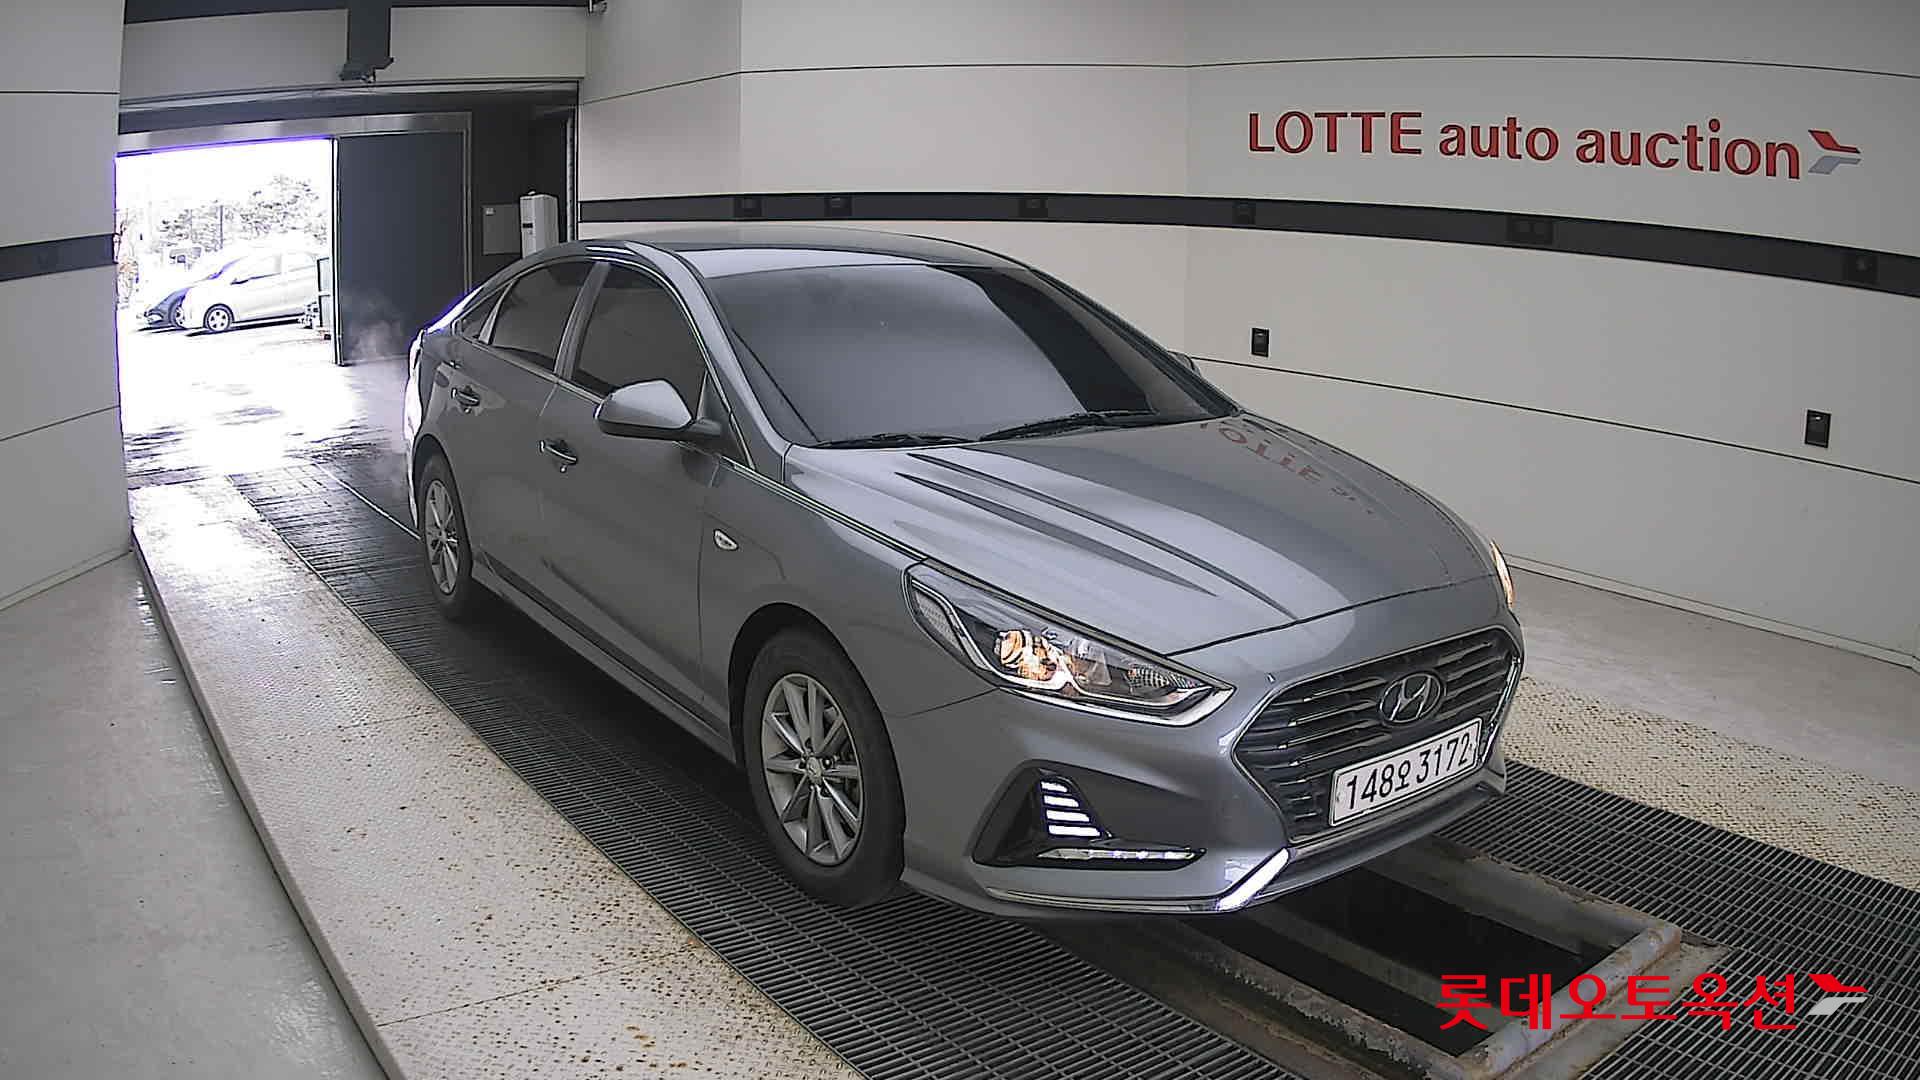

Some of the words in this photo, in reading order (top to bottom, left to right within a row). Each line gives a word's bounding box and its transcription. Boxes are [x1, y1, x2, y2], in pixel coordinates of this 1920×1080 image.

[1248, 111, 1422, 155] LOTTE
[1439, 116, 1560, 161] auto
[1575, 118, 1801, 180] auction
